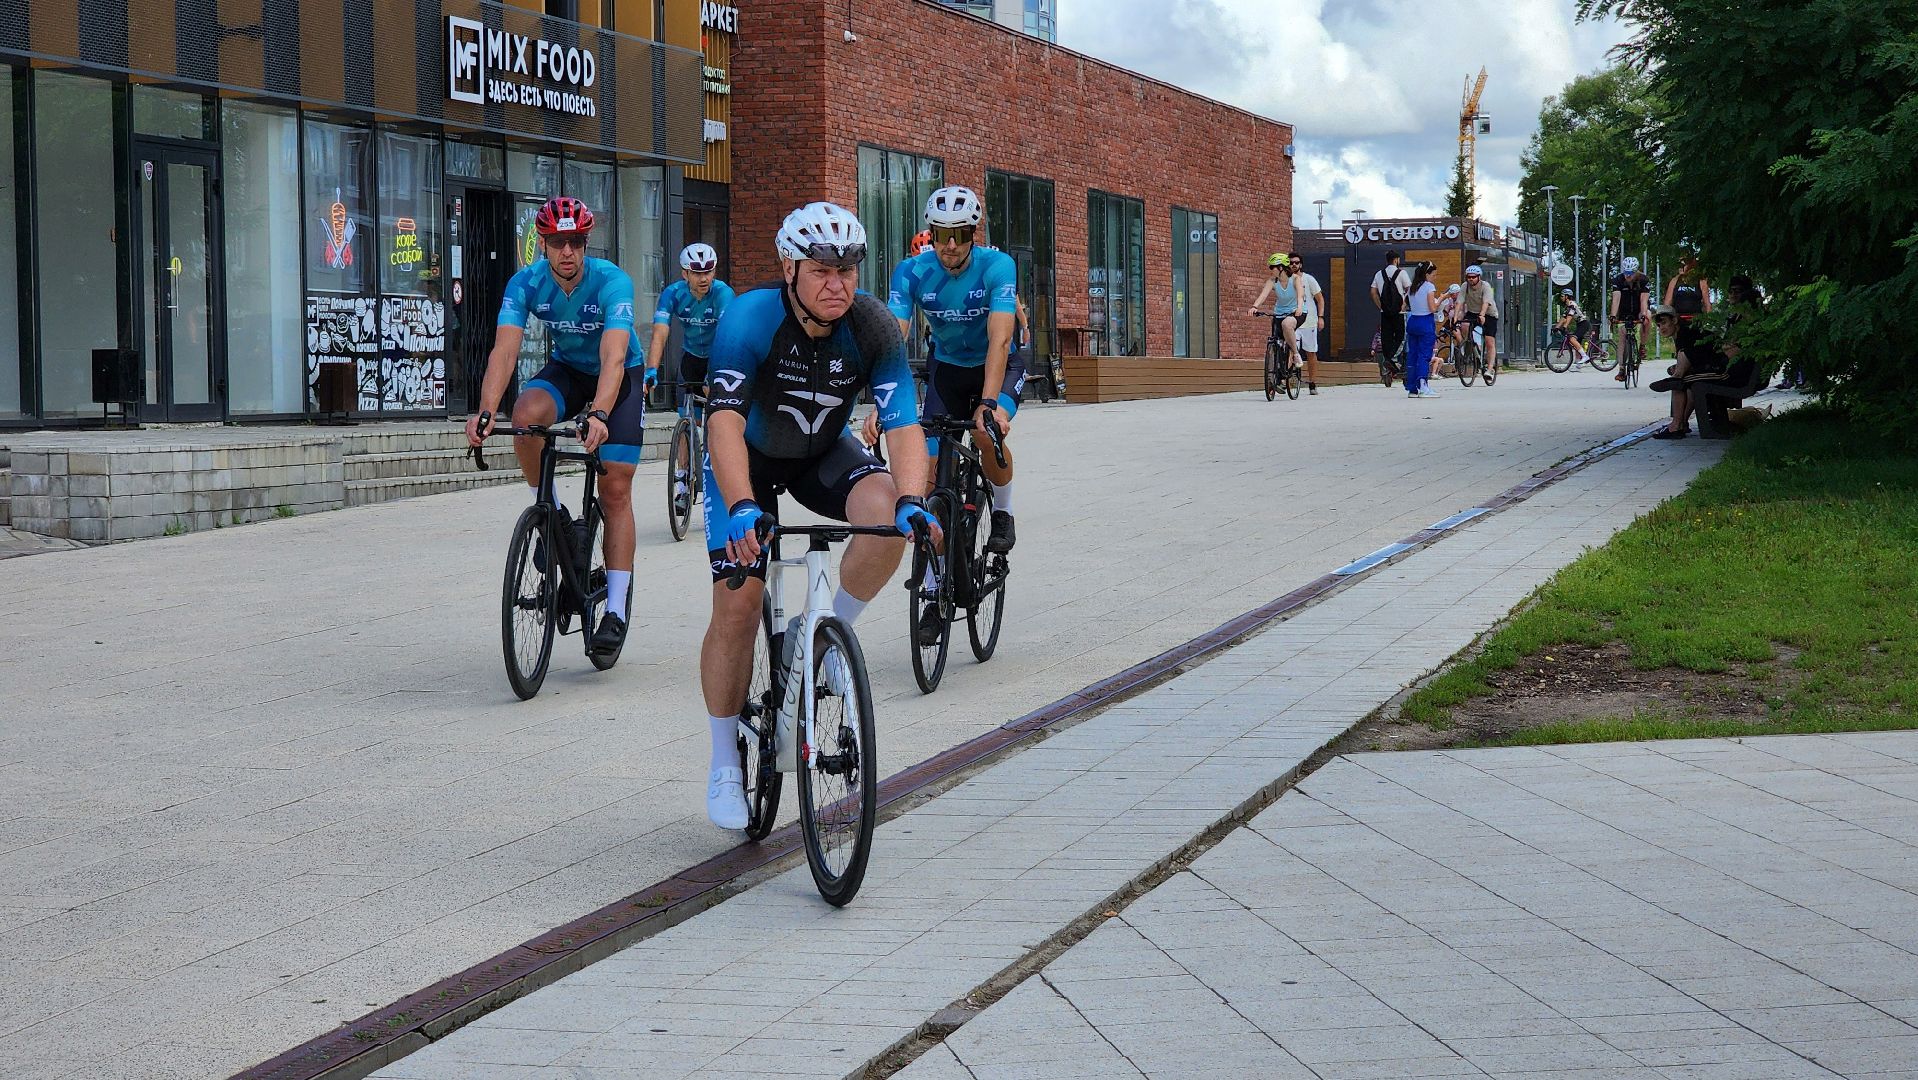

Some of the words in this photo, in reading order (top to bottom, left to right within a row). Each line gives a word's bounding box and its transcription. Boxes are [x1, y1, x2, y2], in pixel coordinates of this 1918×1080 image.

[701, 0, 739, 34] АРКЕТ
[487, 28, 529, 75] MIX
[537, 39, 596, 87] FOOD
[488, 78, 518, 104] ЗДЕСЬ
[520, 84, 542, 107] ЕСТЬ
[543, 89, 561, 111] ЧТО
[562, 94, 596, 117] ПОЕСТЬ
[1368, 225, 1459, 241] СТОЛОТО
[403, 299, 416, 309] MIX
[403, 311, 421, 321] FOOD
[778, 358, 809, 372] AURUM
